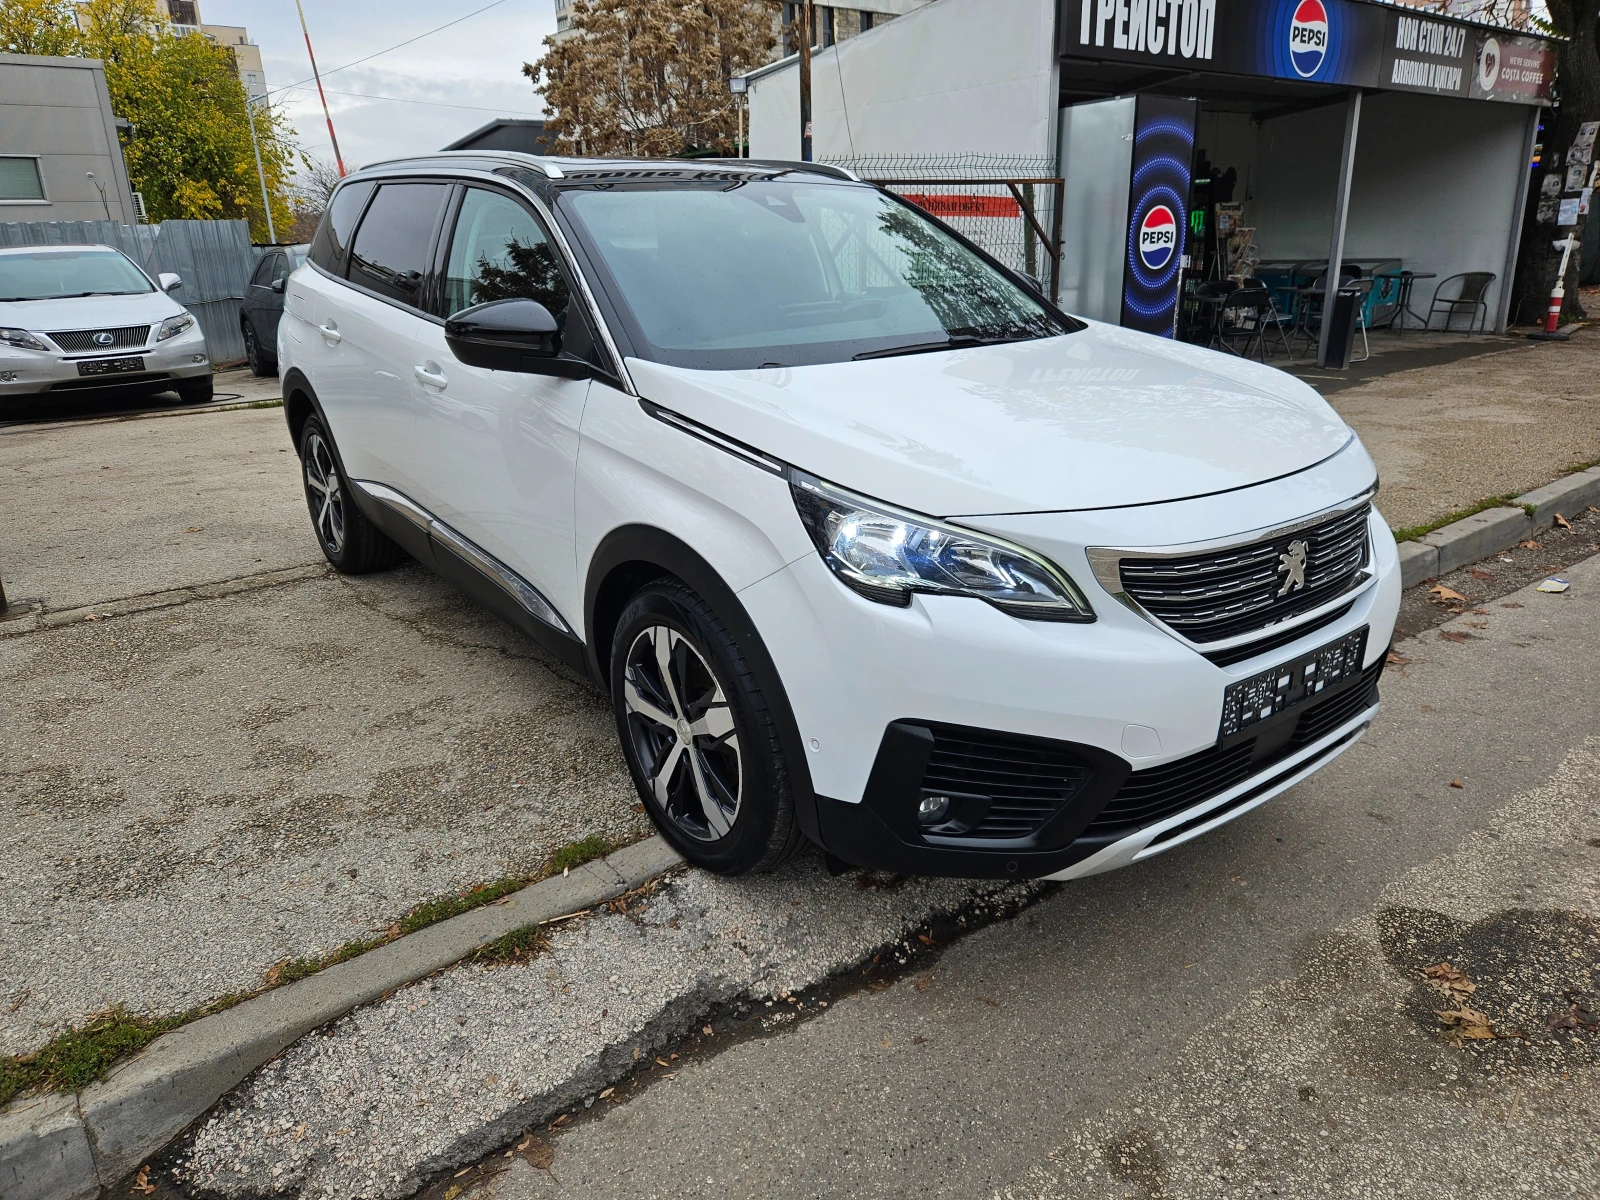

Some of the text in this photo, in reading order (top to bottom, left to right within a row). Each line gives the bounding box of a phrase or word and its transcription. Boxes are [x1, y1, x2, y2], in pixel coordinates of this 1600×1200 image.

[1292, 26, 1326, 47] PEPSI
[1396, 16, 1466, 58] НОН СТОП 24/7
[1523, 58, 1540, 69] SERVING
[1391, 58, 1462, 92] АЛКОХОЛ И ЦИГАРИ
[1502, 67, 1544, 84] COSTA COFFEE
[1142, 231, 1173, 244] PEPSI
